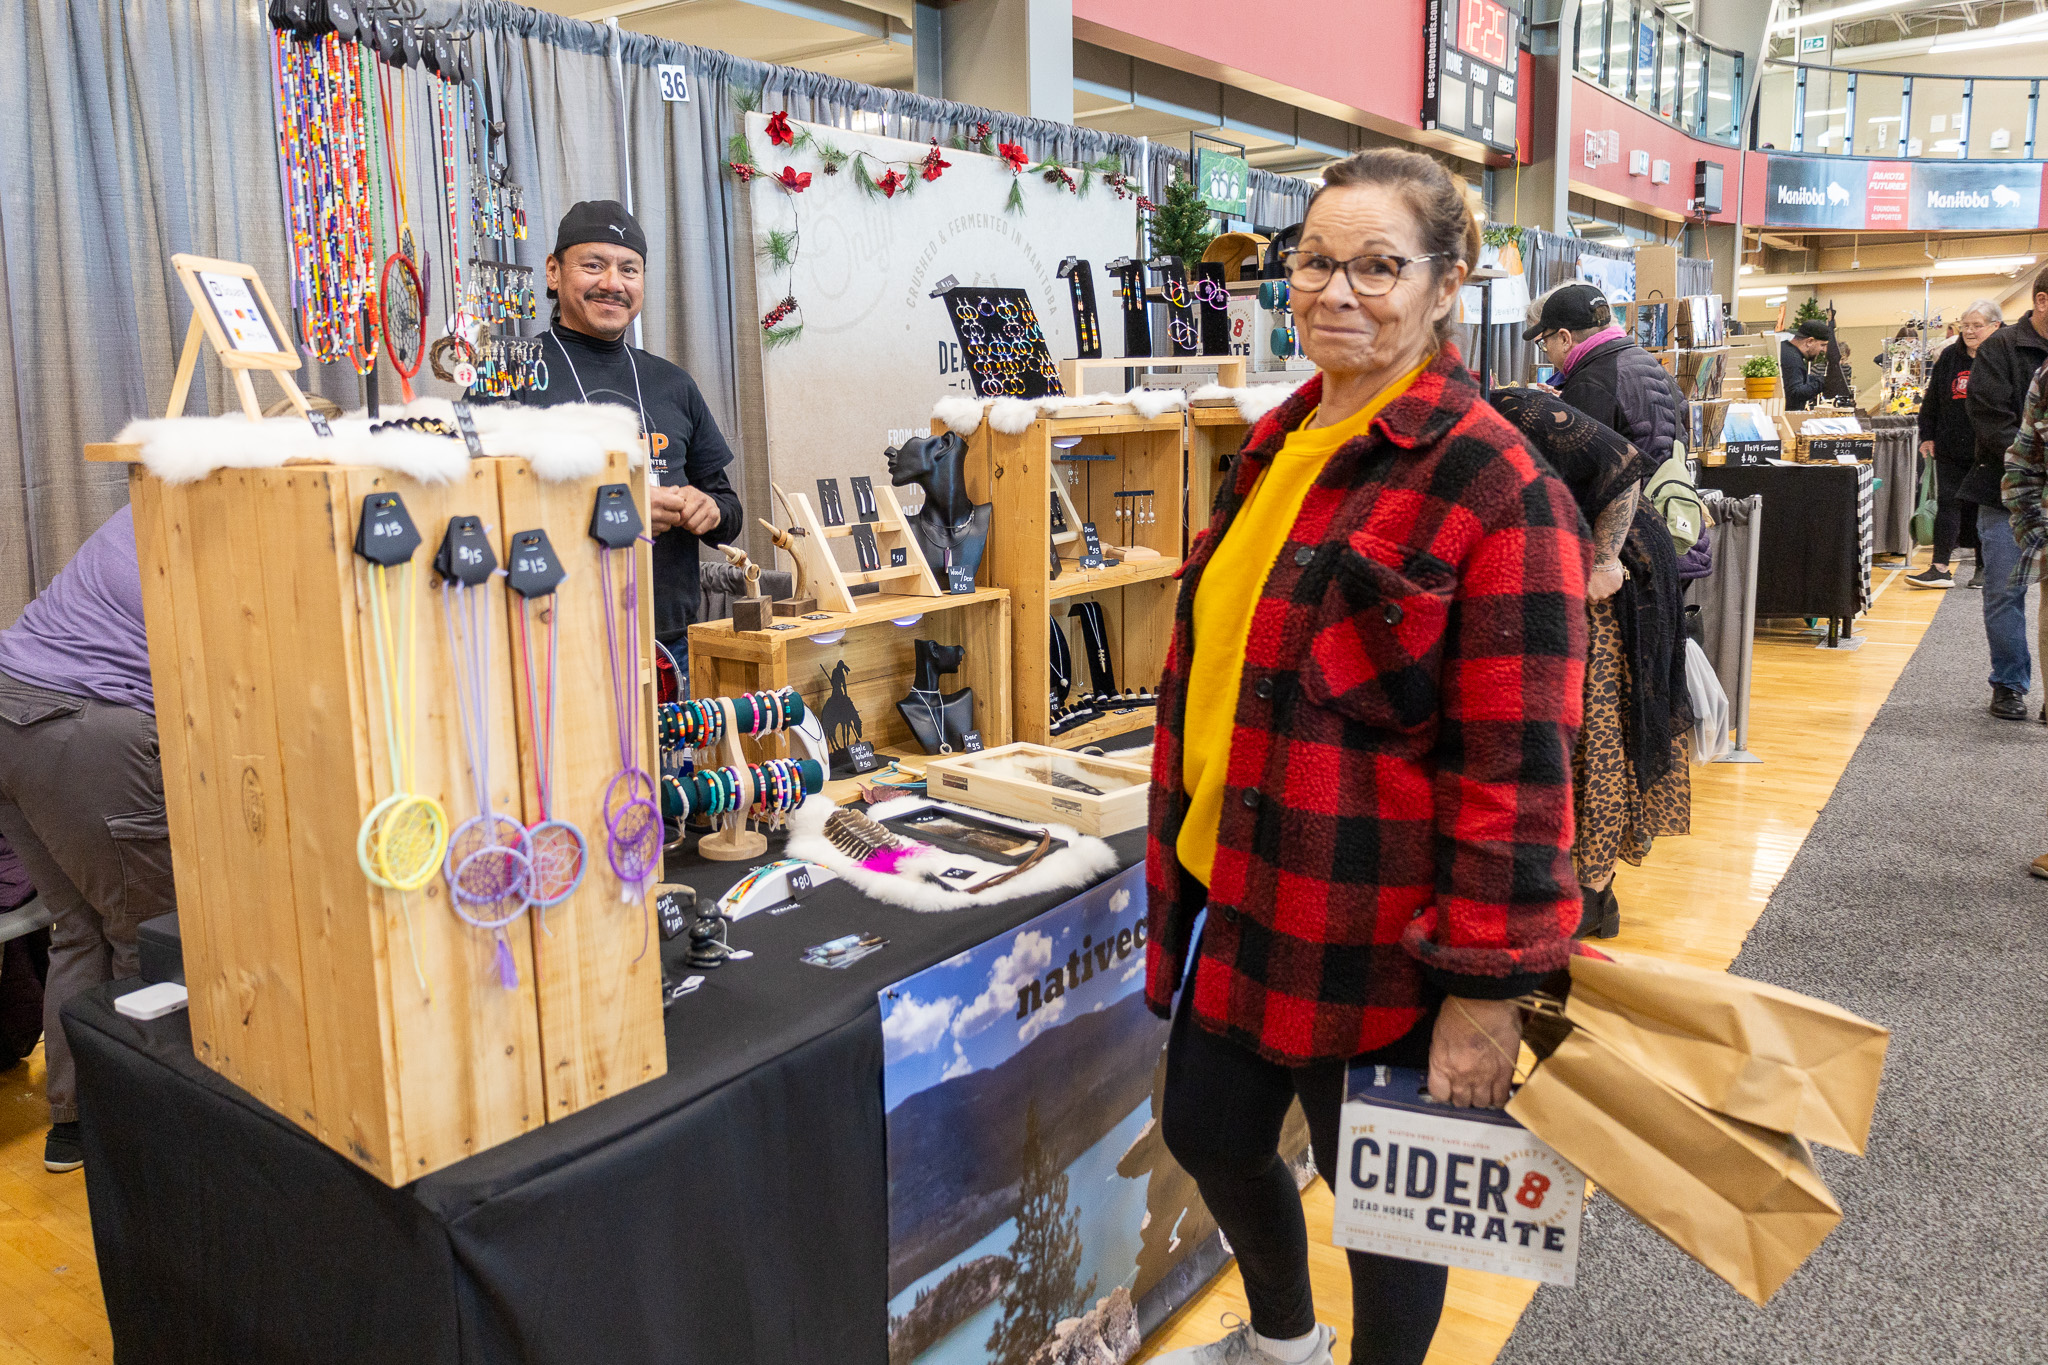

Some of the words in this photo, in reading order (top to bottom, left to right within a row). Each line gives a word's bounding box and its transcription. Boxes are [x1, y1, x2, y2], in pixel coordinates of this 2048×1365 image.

[1446, 50, 1463, 75] HOME
[1470, 63, 1488, 86] PERIOD
[661, 71, 687, 98] 36
[1498, 73, 1514, 97] GUEST
[1872, 172, 1905, 181] DAKOTA
[1869, 181, 1907, 190] FUTURES
[1778, 185, 1826, 206] Manitoba
[1927, 190, 1990, 209] Manitoba
[1871, 213, 1902, 221] SUPPORTER
[906, 240, 938, 309] CRUSHED
[938, 230, 947, 245] &
[948, 213, 1008, 237] FERMENTED
[1011, 228, 1021, 246] IN
[1023, 242, 1057, 316] MANITOBA
[1233, 318, 1244, 337] 8
[1728, 445, 1740, 454] Fits
[1760, 444, 1779, 452] Frame
[1813, 441, 1828, 449] Fits
[1855, 440, 1873, 448] Frame
[1741, 453, 1757, 464] $40
[604, 510, 629, 524] $15
[374, 521, 403, 538] $15
[459, 546, 483, 565] $15
[892, 554, 904, 563] $30
[518, 557, 547, 573] $15
[954, 583, 967, 591] $35
[850, 744, 867, 754] Eagle
[792, 873, 810, 890] $80
[657, 895, 673, 910] Eagle
[664, 905, 680, 916] Ring
[1350, 1124, 1375, 1135] THE
[1350, 1137, 1511, 1214] CIDER
[1515, 1171, 1552, 1209] 8
[1352, 1198, 1379, 1212] DEAD
[1382, 1205, 1415, 1220] HORSE
[1425, 1208, 1566, 1253] CRATE
